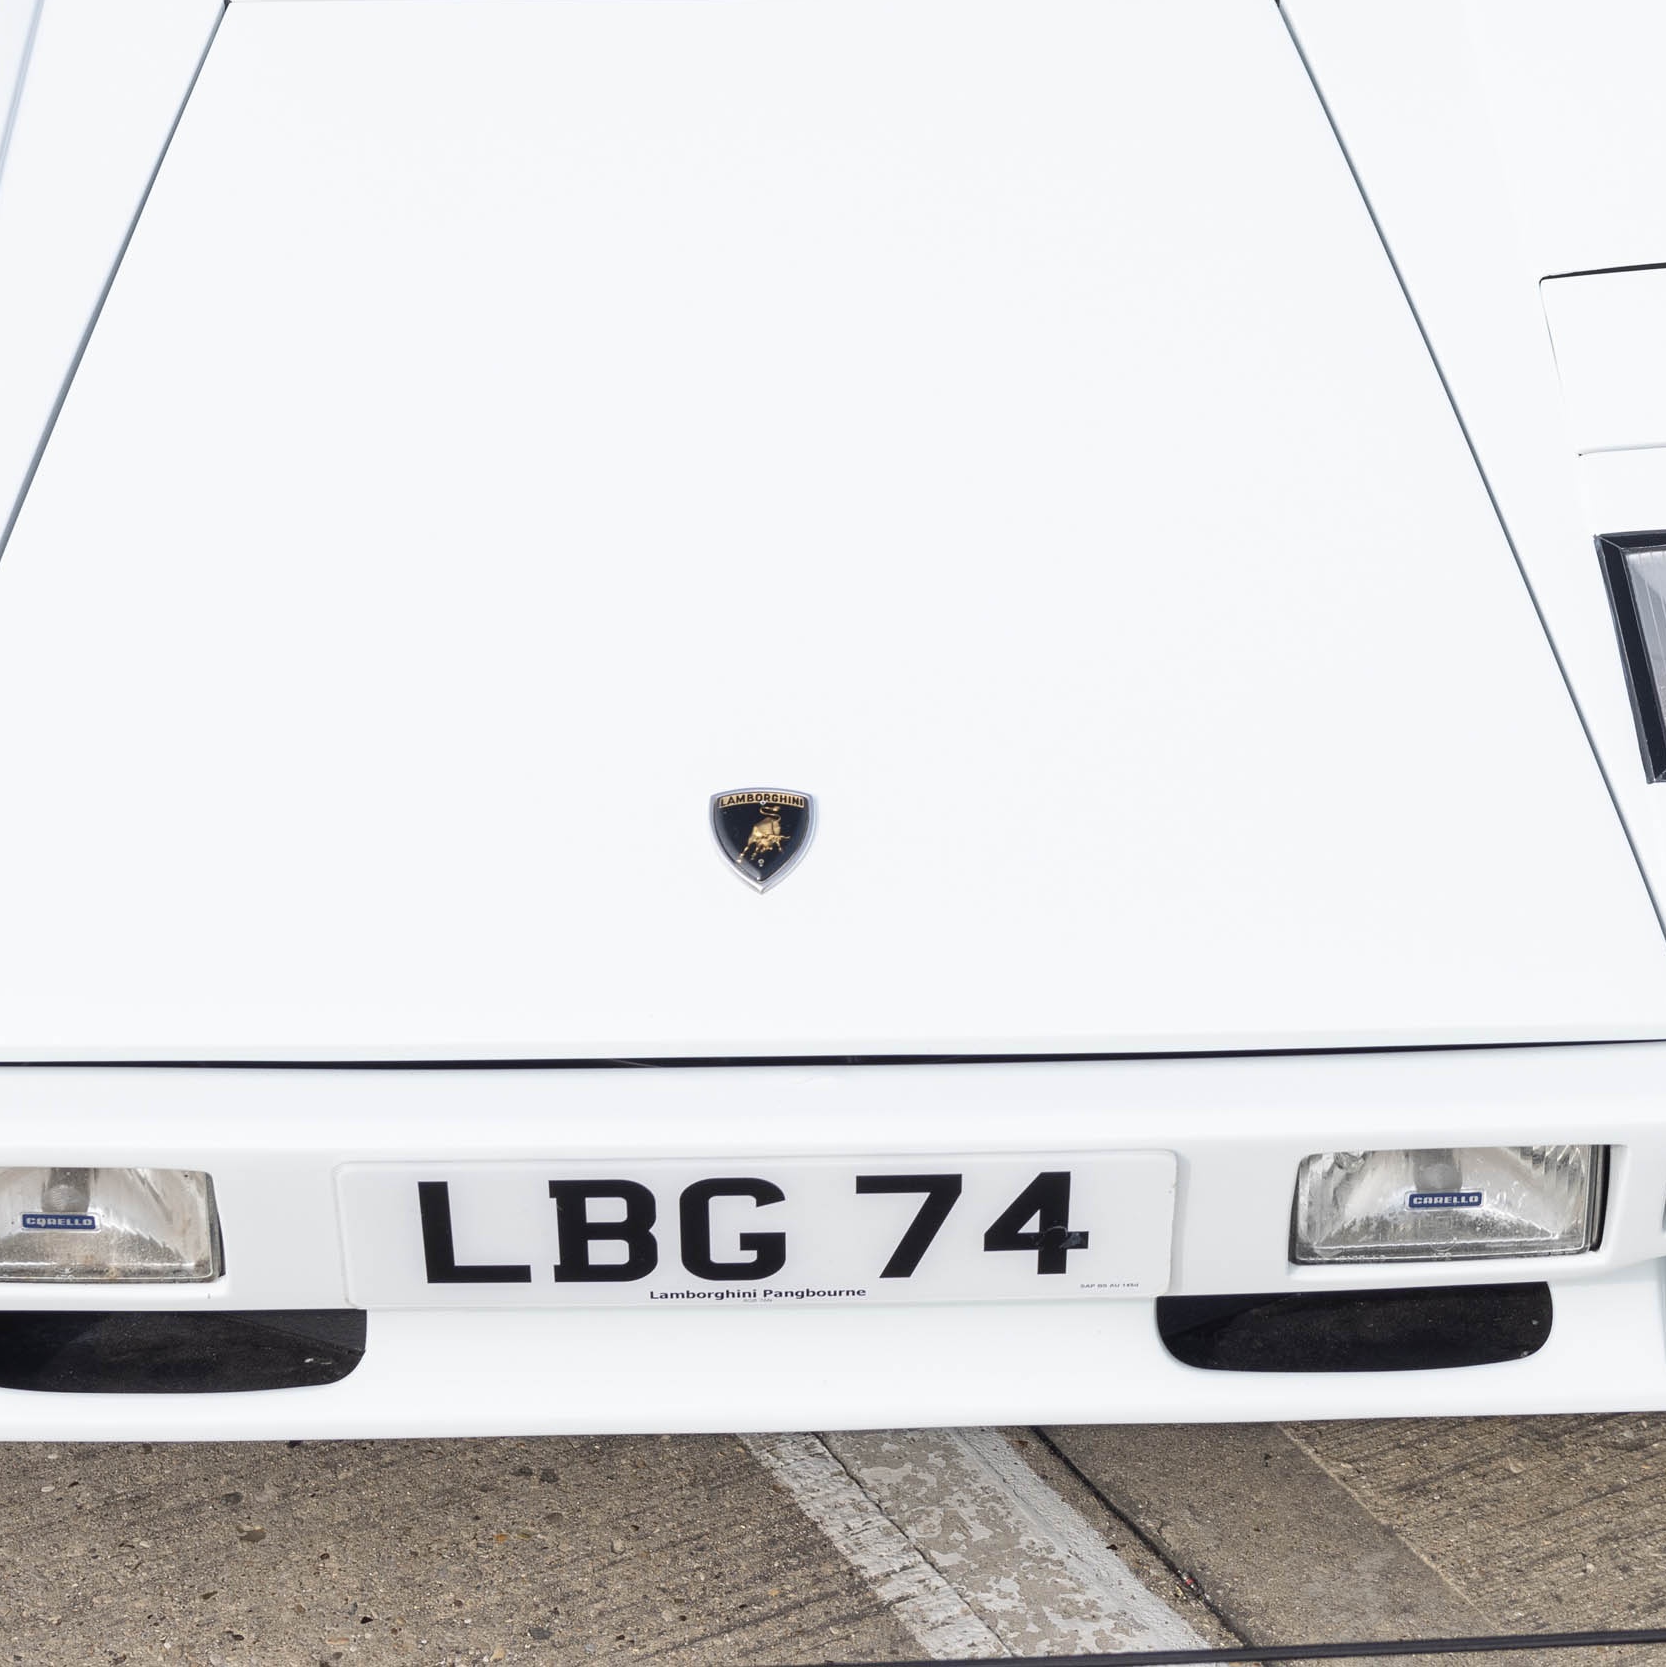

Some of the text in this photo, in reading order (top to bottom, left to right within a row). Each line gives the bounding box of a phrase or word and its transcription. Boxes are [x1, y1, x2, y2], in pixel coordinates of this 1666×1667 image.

[719, 793, 805, 808] LAMBORGHINI
[1412, 1195, 1479, 1205] CARELLO
[418, 1171, 1089, 1284] LBG 74
[649, 1287, 867, 1301] Lamborghini Pangbourne
